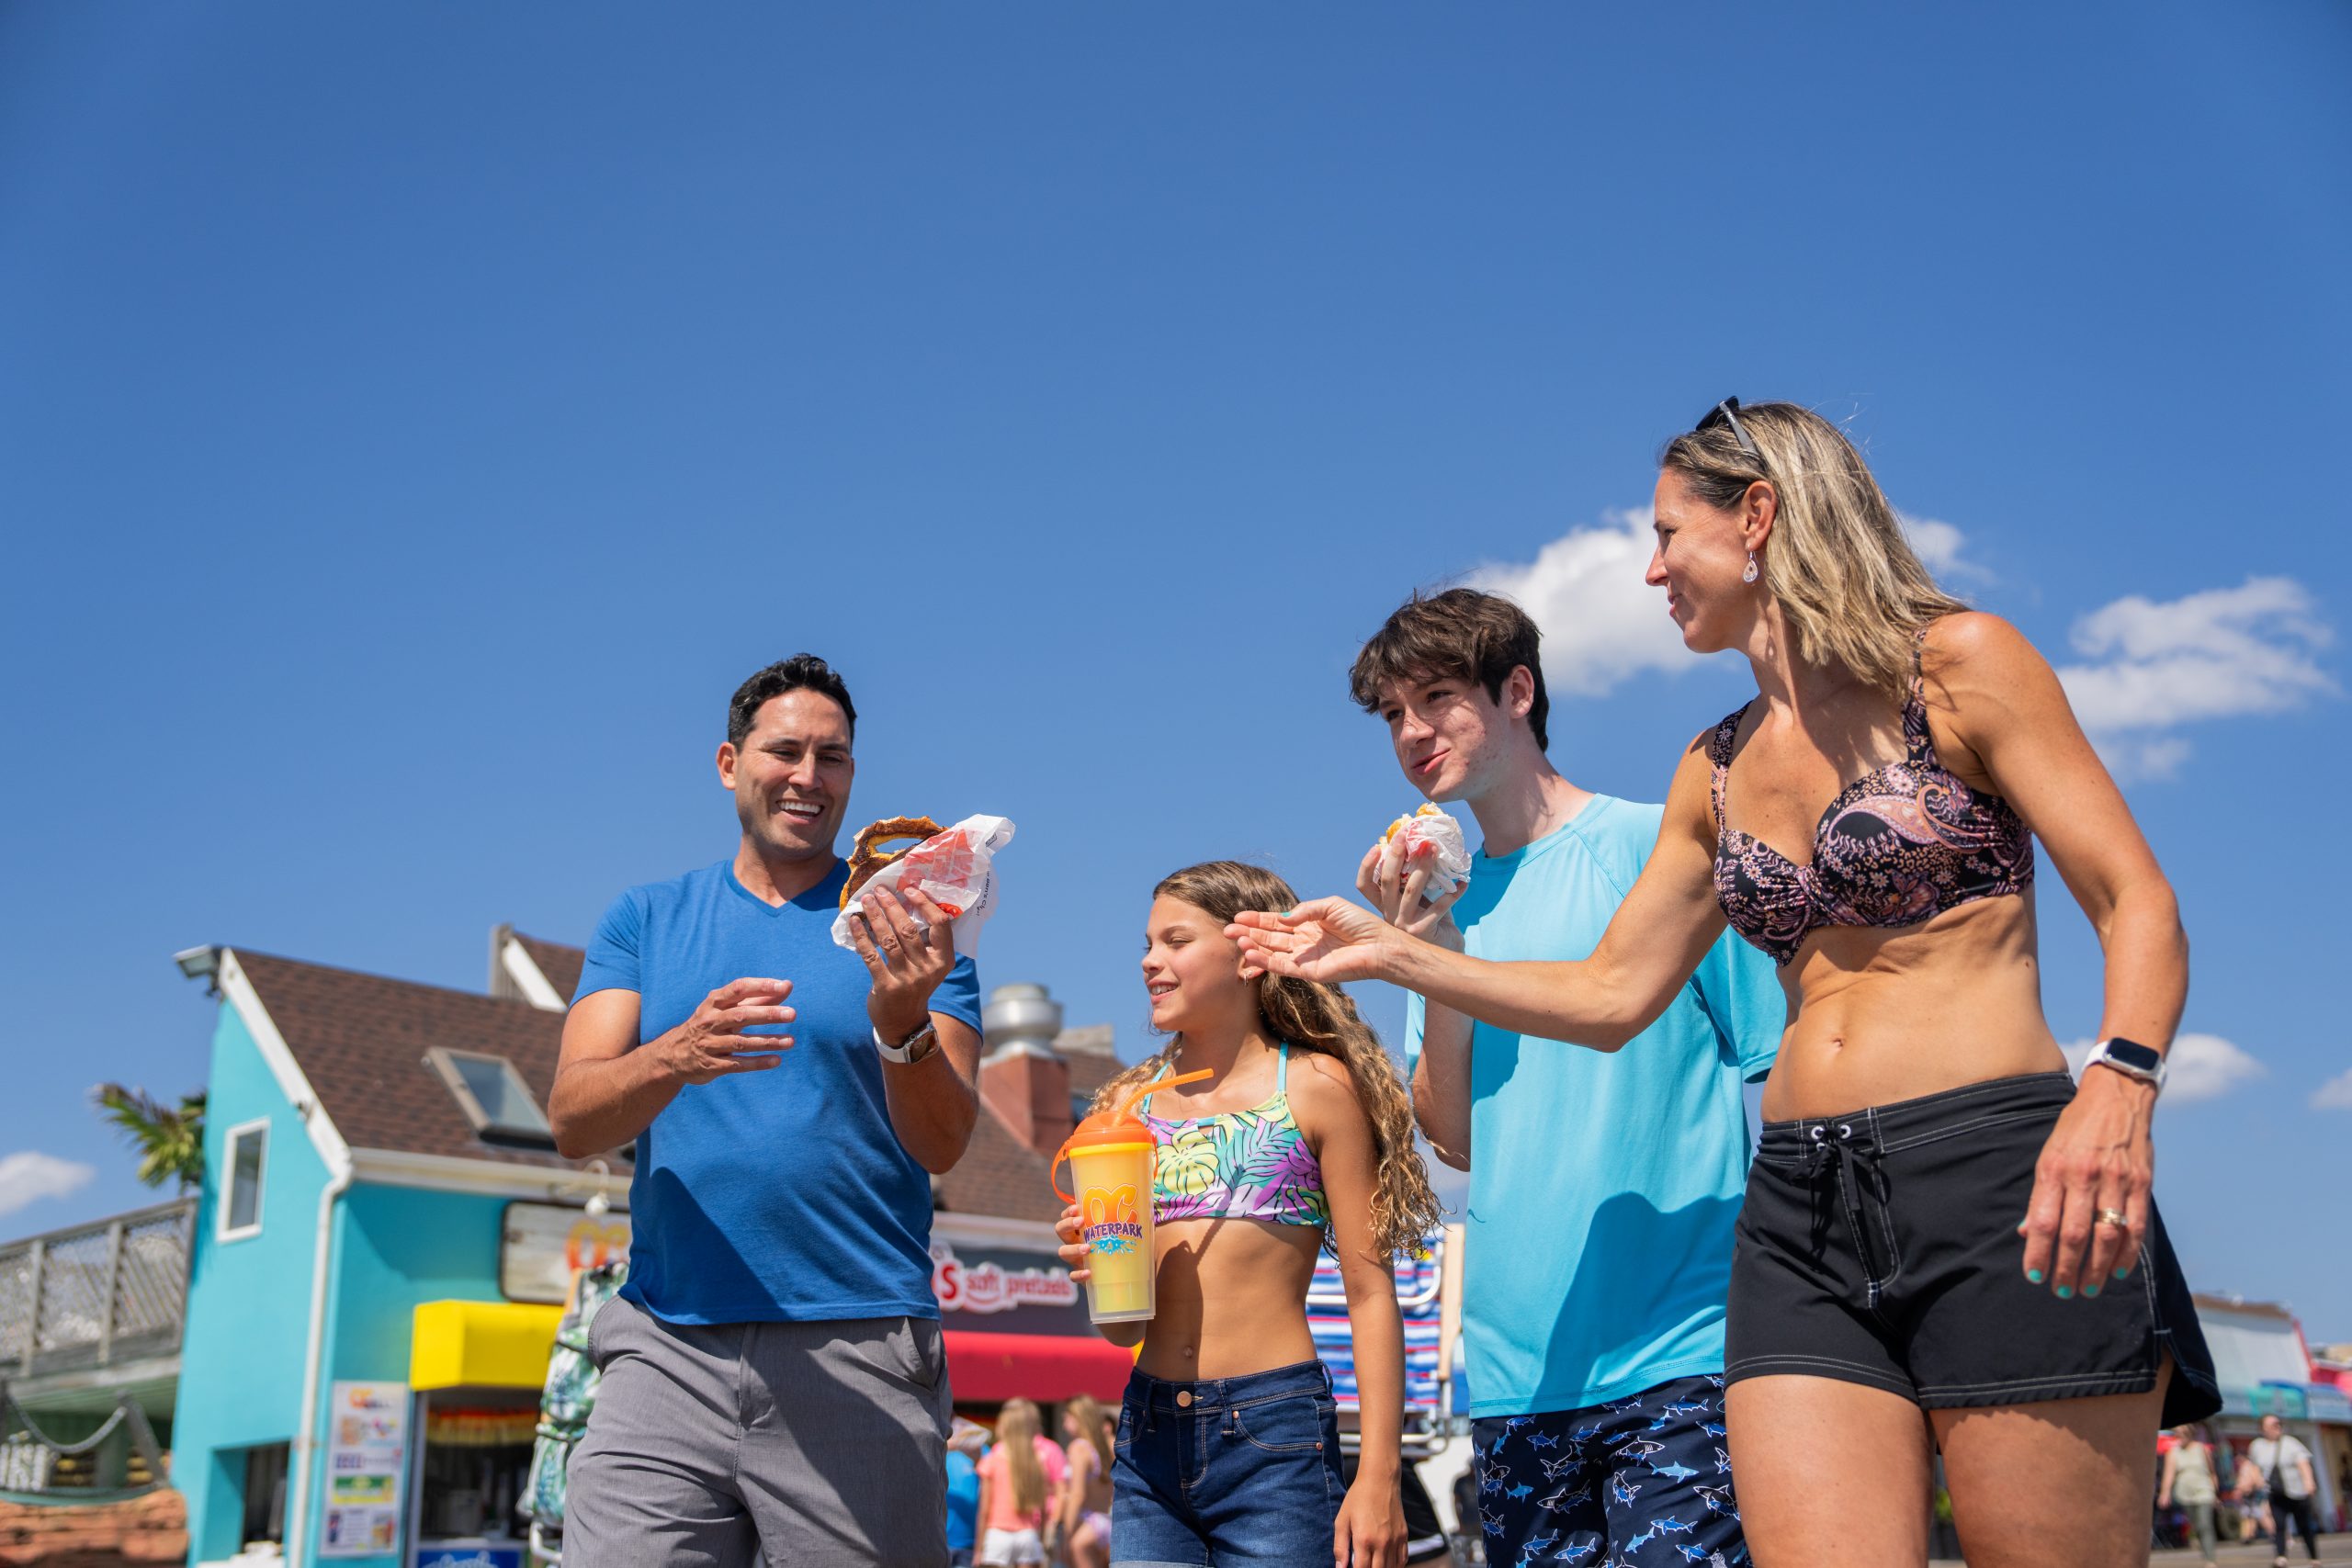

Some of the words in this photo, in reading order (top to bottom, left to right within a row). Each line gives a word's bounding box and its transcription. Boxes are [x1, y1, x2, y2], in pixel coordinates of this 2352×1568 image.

[1082, 1183, 1138, 1227] OC
[1084, 1223, 1143, 1244] WATERPARK
[1007, 1271, 1072, 1298] pretzels
